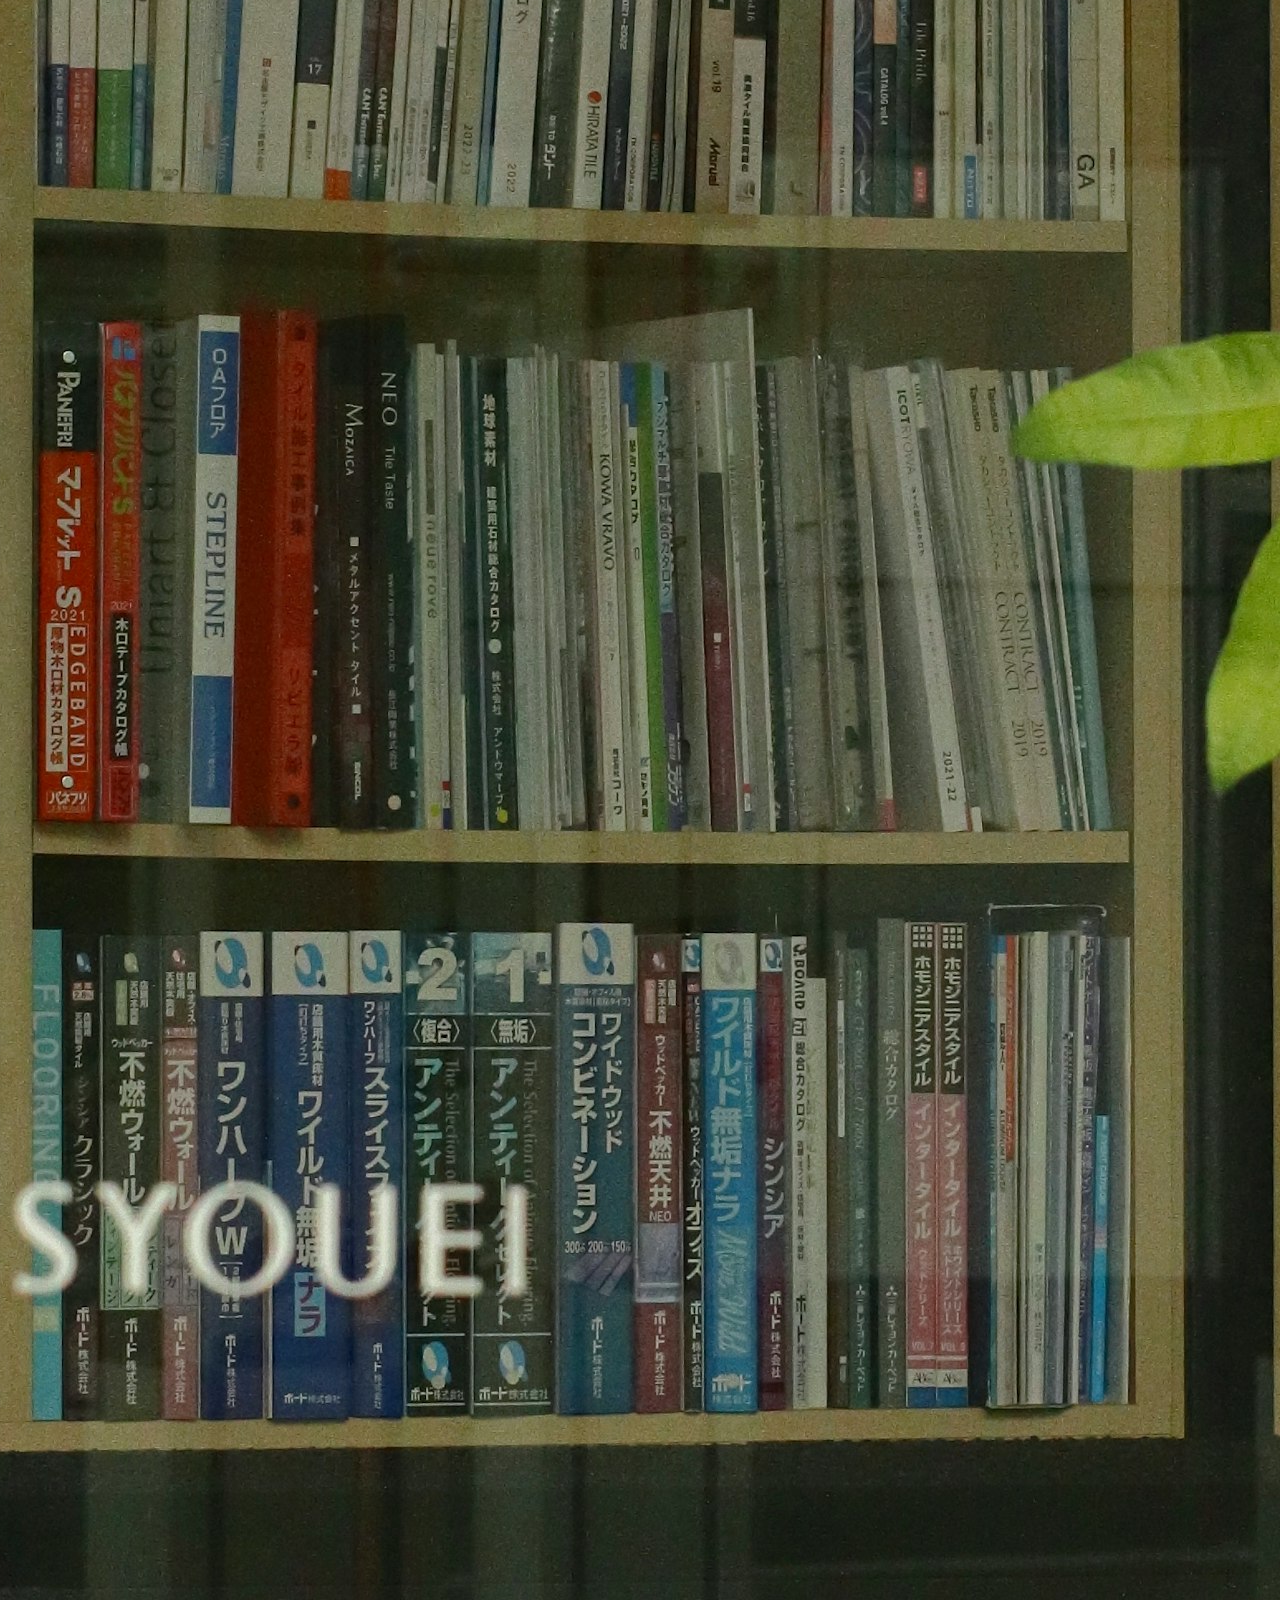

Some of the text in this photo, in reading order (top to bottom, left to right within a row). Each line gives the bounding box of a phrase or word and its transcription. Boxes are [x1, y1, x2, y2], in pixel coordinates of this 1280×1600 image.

[584, 104, 601, 180] HIRATA TILE
[1072, 153, 1092, 190] GA
[380, 371, 399, 428] NEO
[896, 389, 911, 427] ICOT
[598, 452, 612, 494] KOWA
[49, 608, 87, 624] 2021
[199, 490, 225, 640] STEPLINE
[993, 591, 1020, 696] CONTRACT
[1013, 591, 1038, 694] CONTRACT
[69, 625, 86, 769] EDGEBAND
[417, 948, 458, 1001] 2
[492, 949, 525, 1002] 1
[913, 955, 933, 1087] ホモジニアスタイル
[942, 956, 961, 1082] ホモジニアスタイル
[571, 1013, 623, 1235] ワイドウッド コンビネーション
[650, 1109, 673, 1210] 不燃天井
[762, 1136, 784, 1240] シンシア
[10, 1179, 532, 1300] SYOUEI
